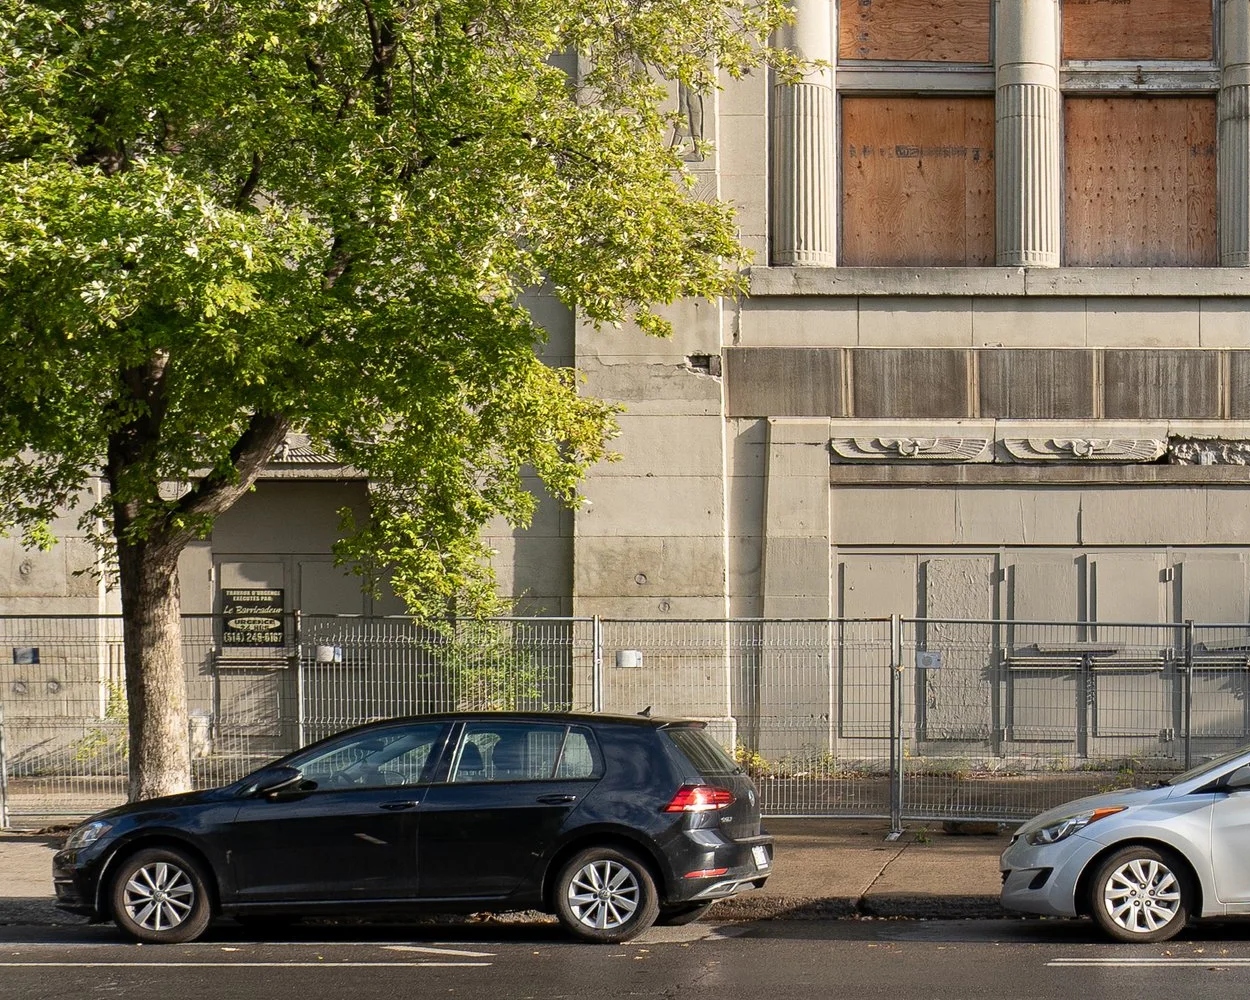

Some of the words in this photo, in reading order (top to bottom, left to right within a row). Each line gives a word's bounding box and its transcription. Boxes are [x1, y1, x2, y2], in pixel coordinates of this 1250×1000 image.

[223, 605, 234, 614] Le
[235, 605, 283, 614] Barricadeur
[223, 632, 245, 643] (514)
